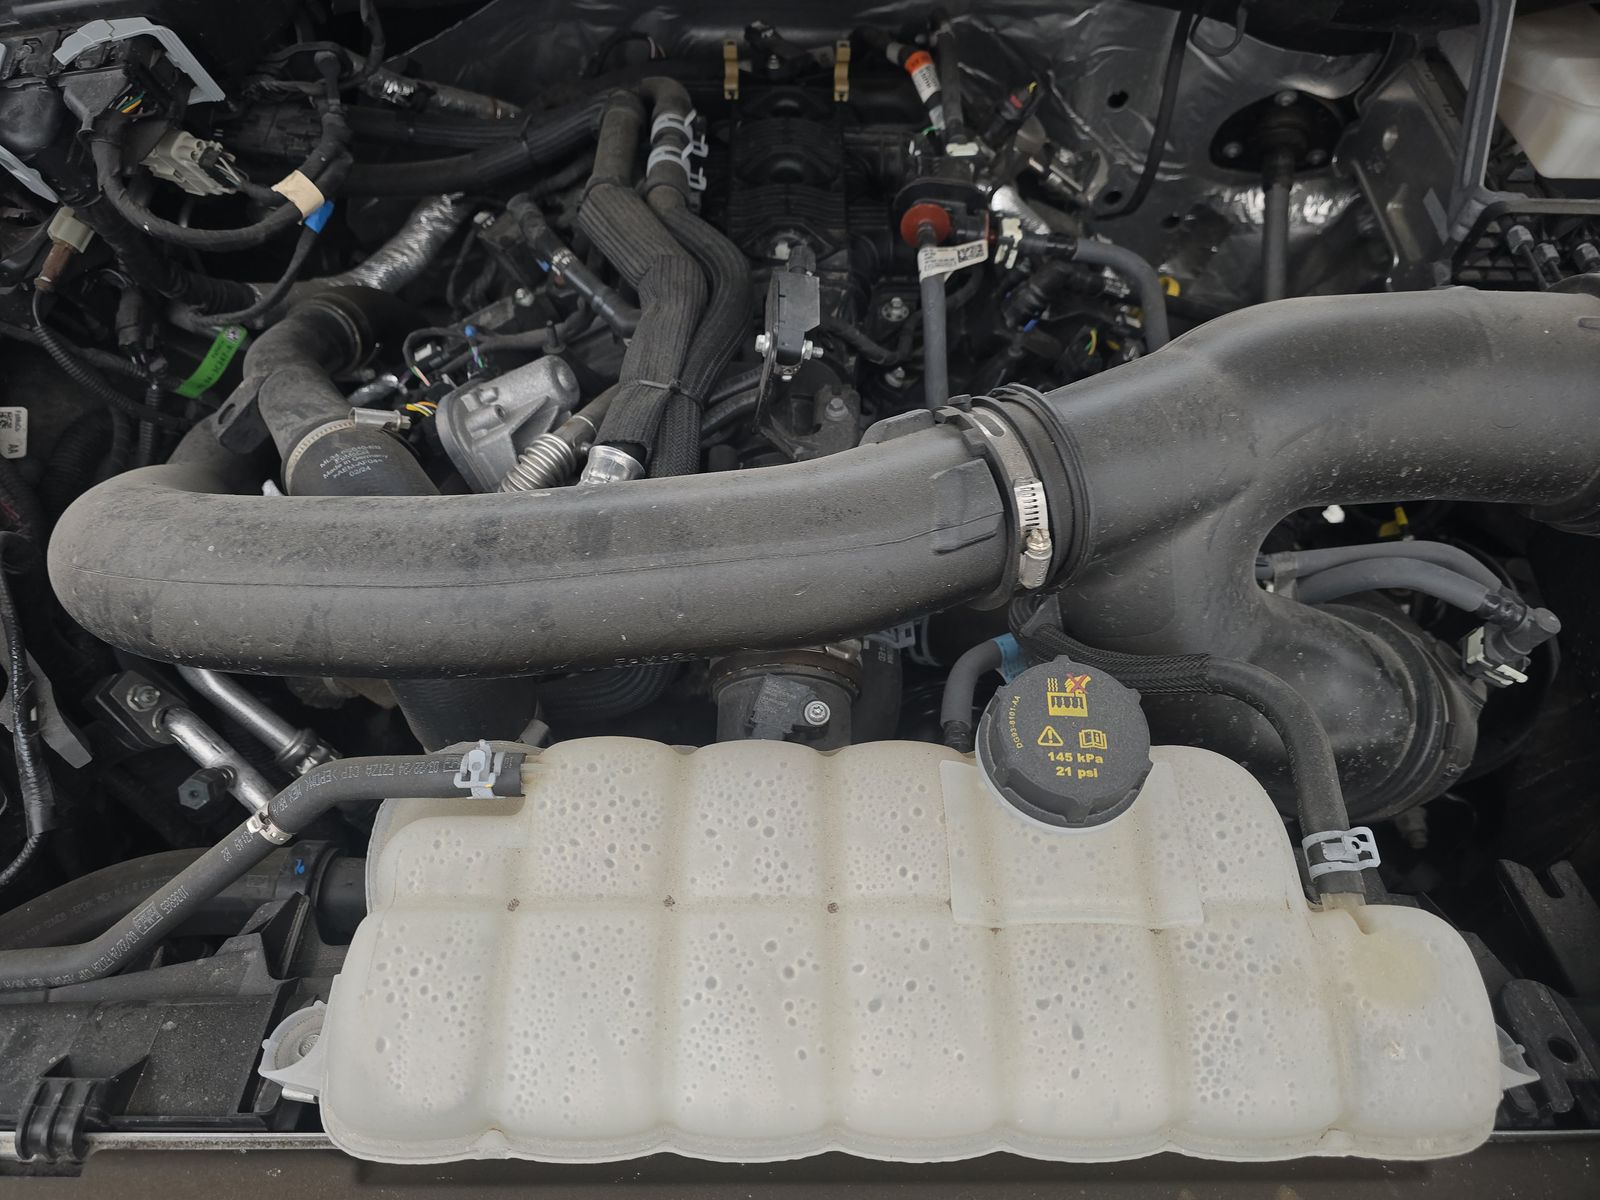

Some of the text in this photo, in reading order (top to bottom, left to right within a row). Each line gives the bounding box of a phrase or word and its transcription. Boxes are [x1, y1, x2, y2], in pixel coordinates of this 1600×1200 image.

[323, 463, 342, 478] Made
[1047, 751, 1104, 764] 145 kPa
[1055, 766, 1098, 780] 21 psi
